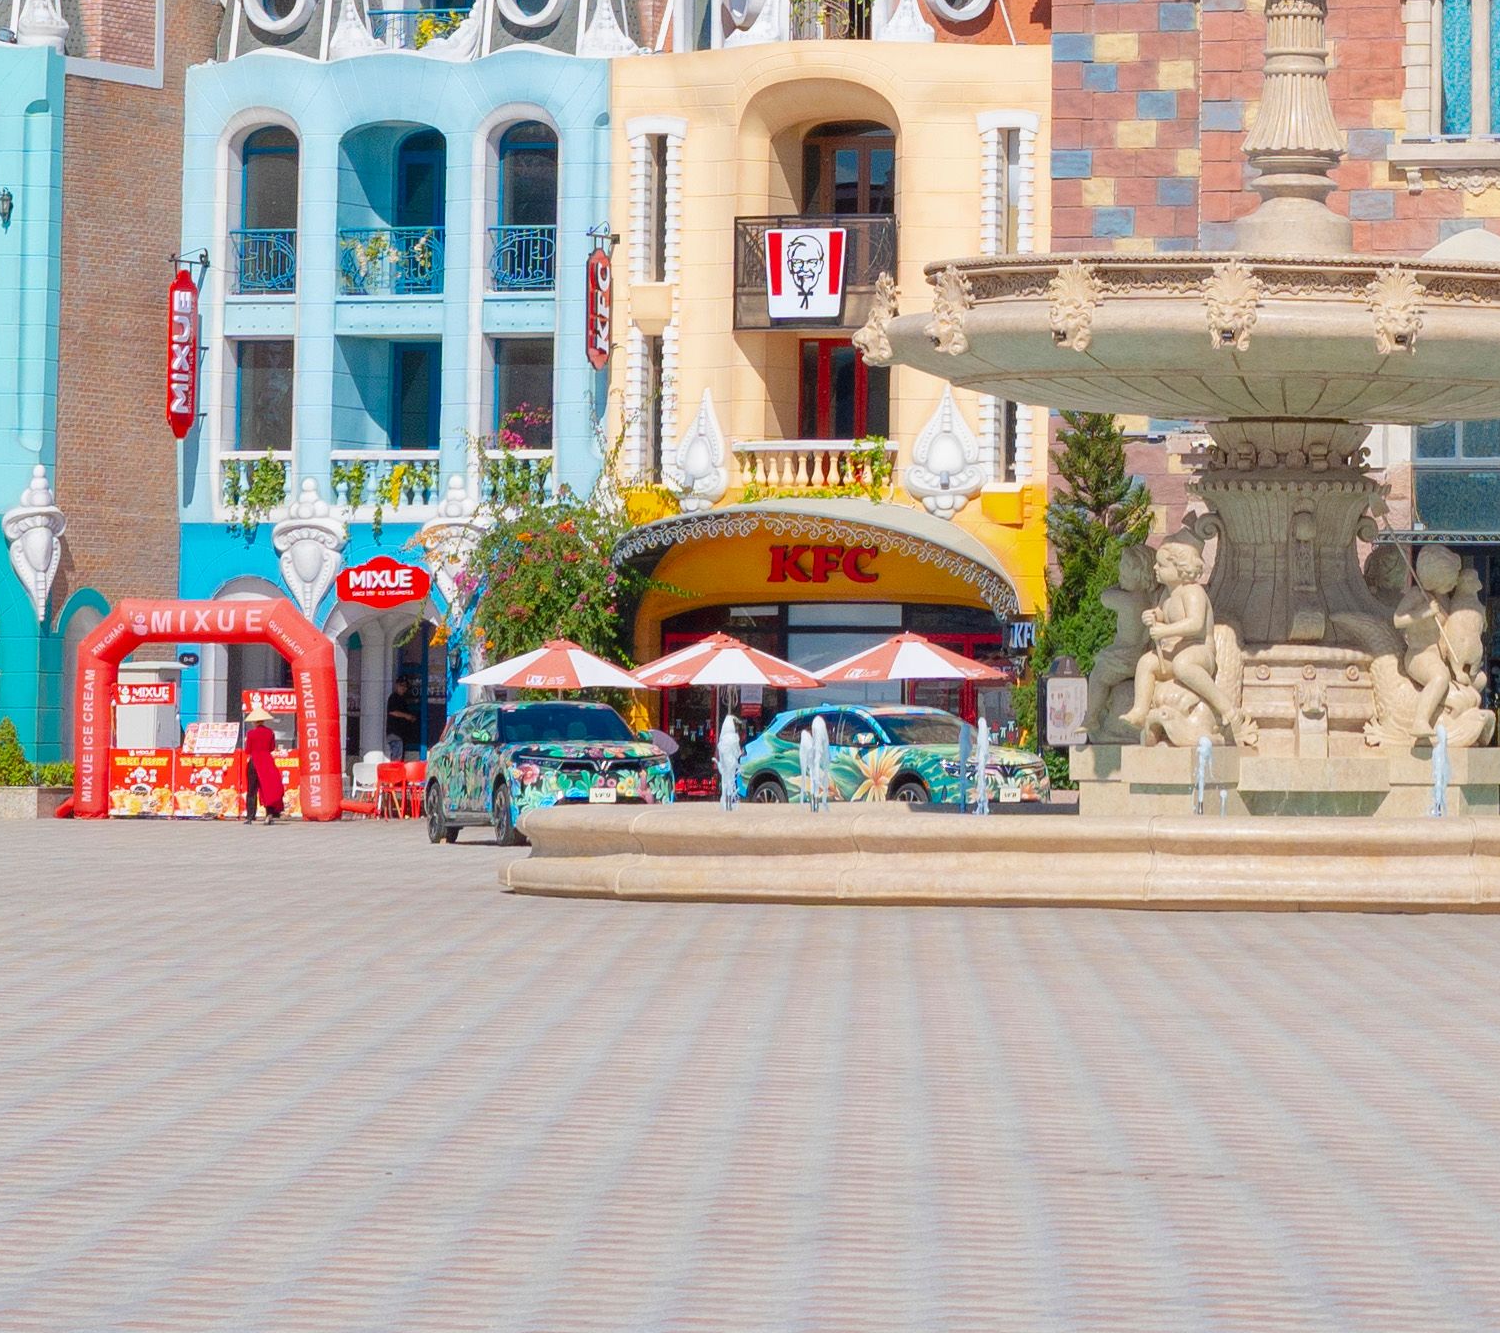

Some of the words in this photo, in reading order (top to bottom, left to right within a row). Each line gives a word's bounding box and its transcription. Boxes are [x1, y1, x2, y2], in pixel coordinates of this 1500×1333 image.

[596, 261, 611, 355] KFC
[170, 289, 192, 415] MIXUE
[348, 569, 414, 589] MIXUE
[766, 544, 880, 584] KFC
[150, 608, 264, 633] MIXUE
[83, 669, 96, 722] CREAM
[132, 686, 170, 700] MIXUE
[300, 672, 317, 719] MIXUE
[83, 726, 94, 750] ICE
[306, 722, 319, 748] ICE
[82, 753, 93, 803] MIXUE
[308, 751, 322, 808] CREAM
